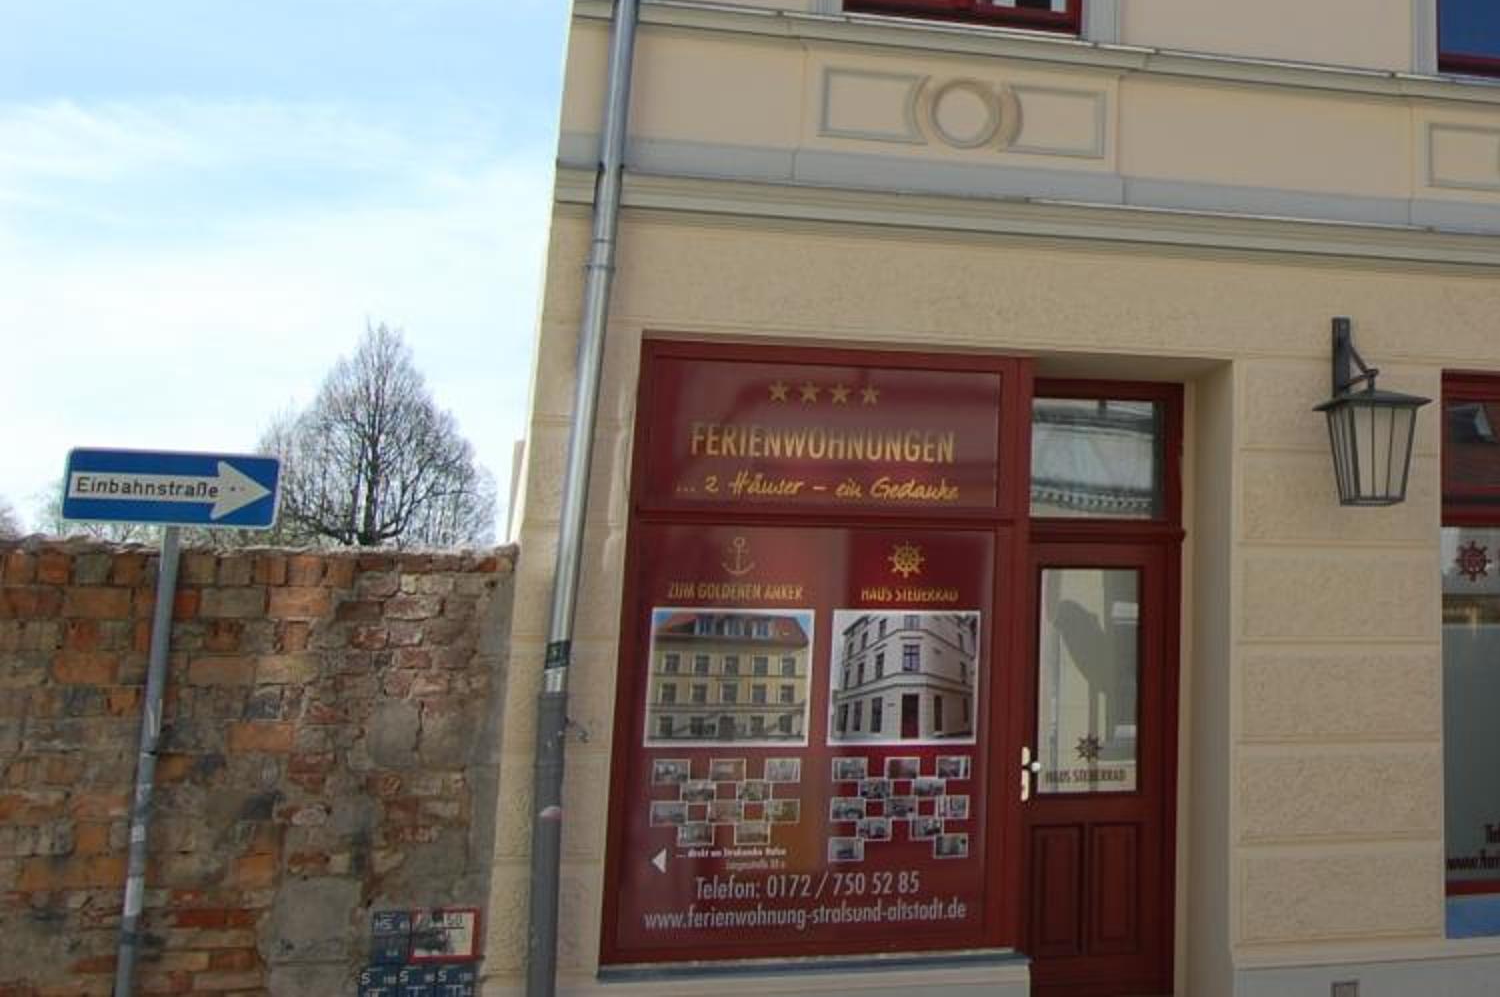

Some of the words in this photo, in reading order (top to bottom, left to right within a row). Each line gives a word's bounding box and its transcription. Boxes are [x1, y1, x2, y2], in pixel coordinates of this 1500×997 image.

[690, 422, 954, 463] FERIENWOHNUNGEN
[76, 476, 219, 498] Einbahnstraße
[704, 478, 719, 493] 2
[835, 481, 862, 498] ein
[870, 476, 960, 501] Gedanke
[668, 582, 695, 600] ZUM
[698, 583, 761, 601] GOLDENEN
[763, 584, 804, 601] ANKER
[861, 587, 892, 603] HAUS
[894, 587, 959, 603] STEUERRAD
[696, 876, 760, 900] Telefon:
[767, 874, 811, 898] 0172
[815, 871, 829, 899] /
[833, 872, 864, 896] 750
[873, 872, 892, 895] 52
[898, 871, 919, 894] 85
[645, 898, 966, 930] www.ferienwohnung-stralsund-altstadt.de
